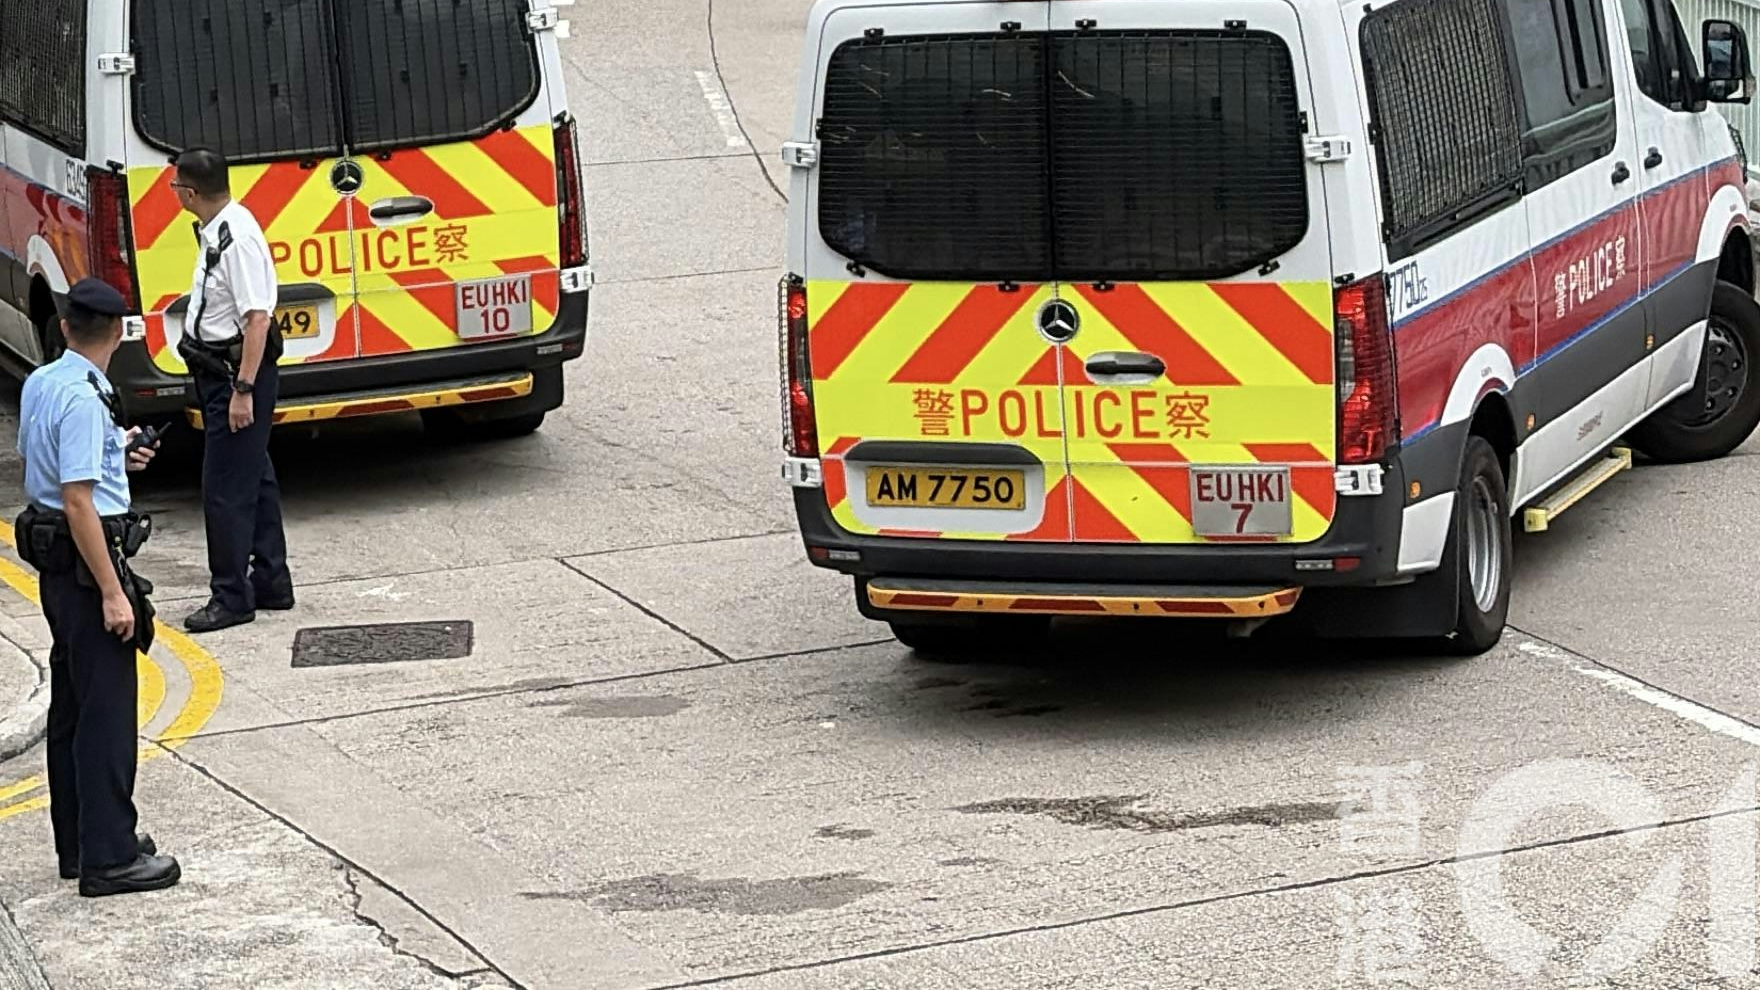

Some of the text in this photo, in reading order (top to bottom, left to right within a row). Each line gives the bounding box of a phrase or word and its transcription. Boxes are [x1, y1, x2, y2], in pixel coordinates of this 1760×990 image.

[1569, 241, 1613, 311] POLICE
[481, 307, 510, 334] 10
[877, 472, 1014, 504] AM 7750
[1231, 503, 1254, 534] 7
